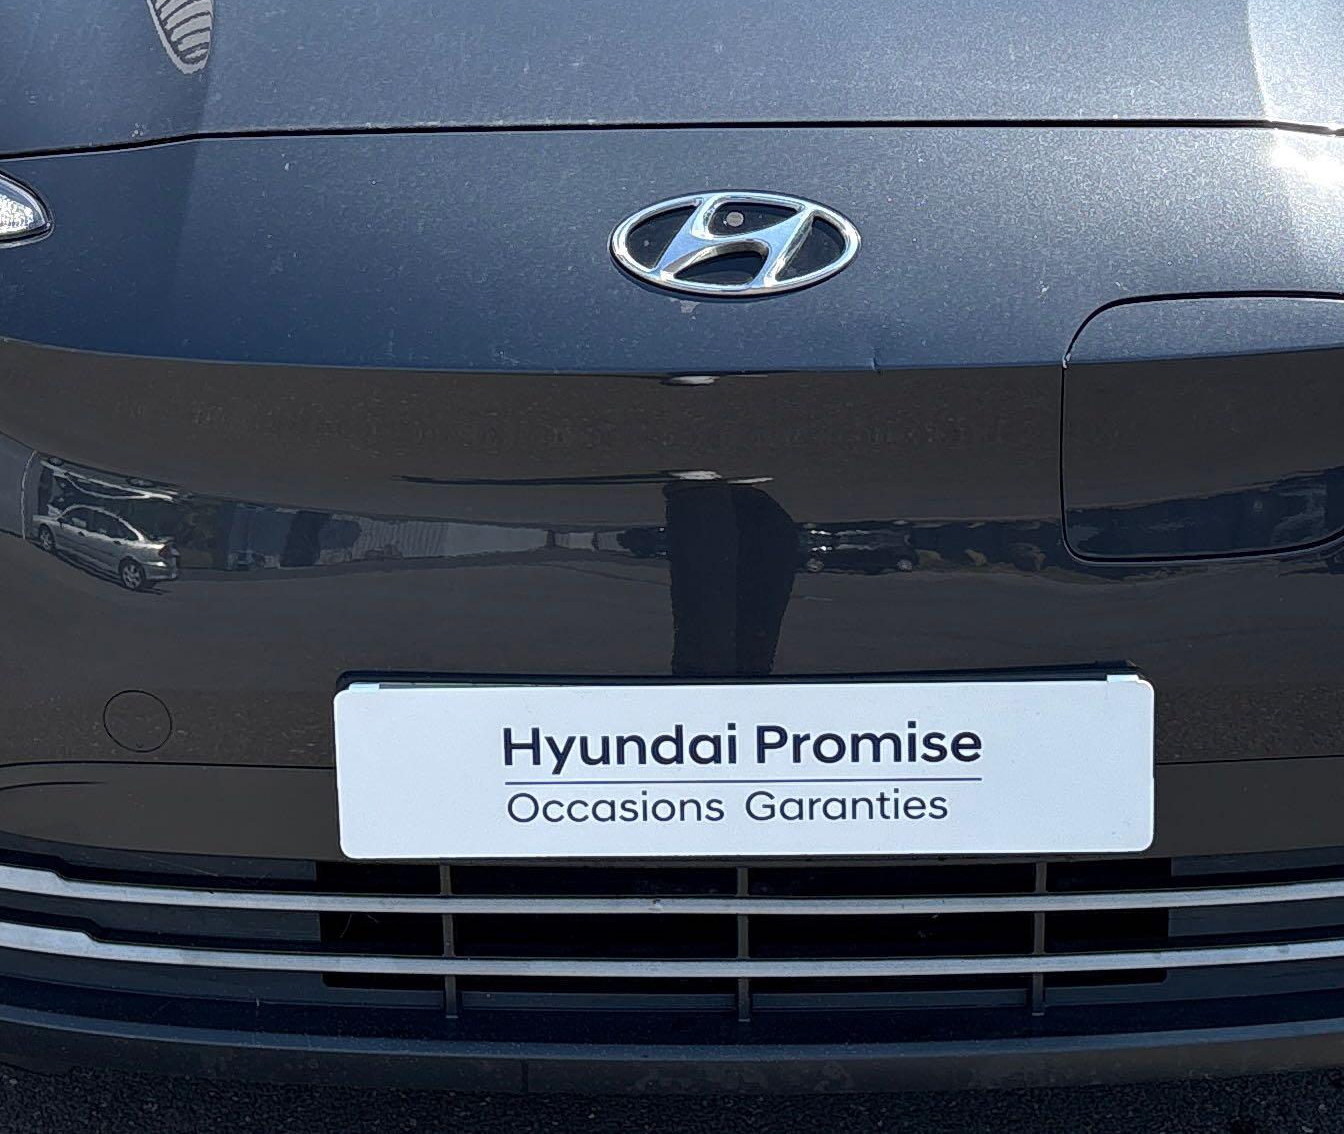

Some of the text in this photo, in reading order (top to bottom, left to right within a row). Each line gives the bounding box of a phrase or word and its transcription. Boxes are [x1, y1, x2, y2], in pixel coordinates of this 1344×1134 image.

[504, 721, 981, 774] Hyundai Promise
[508, 788, 947, 822] Occasions Garanties
